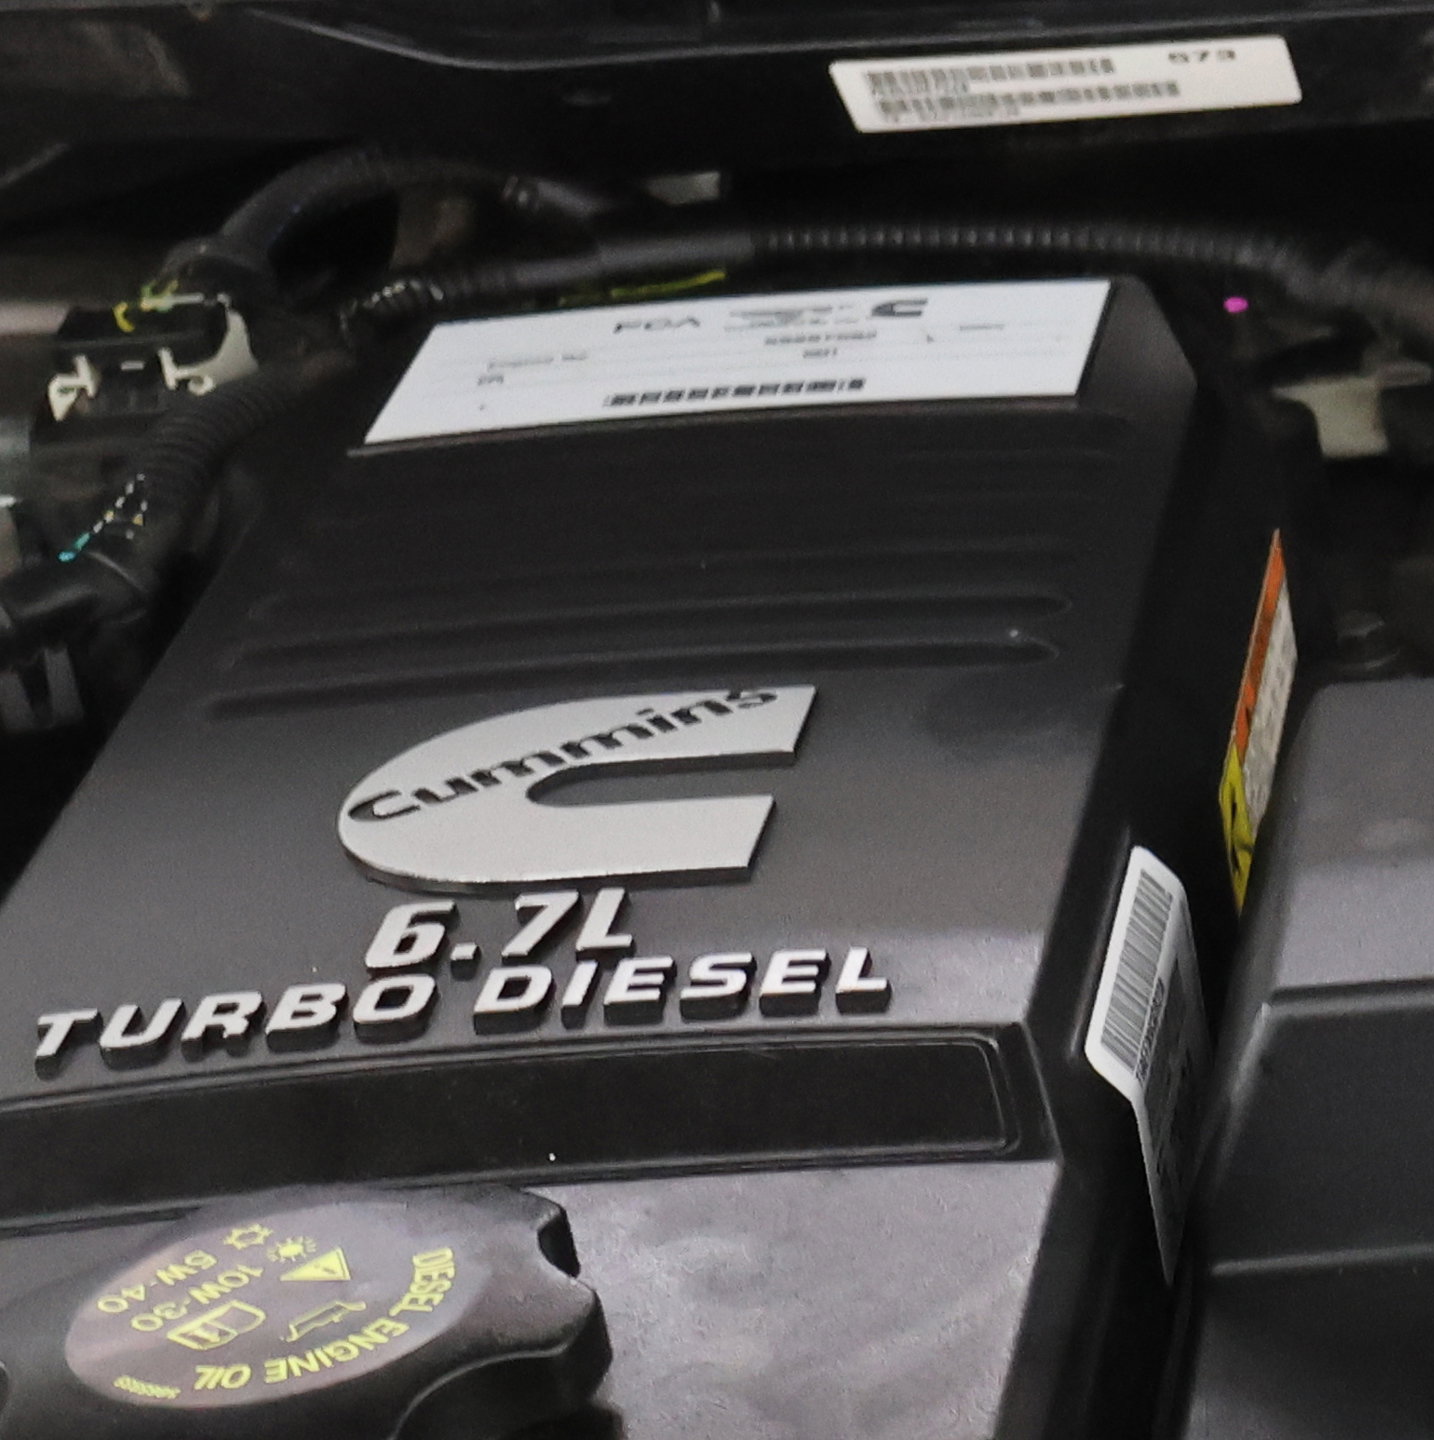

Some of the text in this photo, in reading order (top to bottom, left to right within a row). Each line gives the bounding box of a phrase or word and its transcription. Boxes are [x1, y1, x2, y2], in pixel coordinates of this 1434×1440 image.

[346, 684, 781, 824] Cummins
[364, 886, 635, 978] 6.7L
[34, 945, 894, 1064] TURBO DIESEL
[97, 1249, 218, 1314] 5W-40
[130, 1263, 265, 1332] 10W-30
[389, 1245, 456, 1318] DIESEL
[194, 1363, 253, 1392] OIL
[263, 1316, 411, 1384] ENGINE
